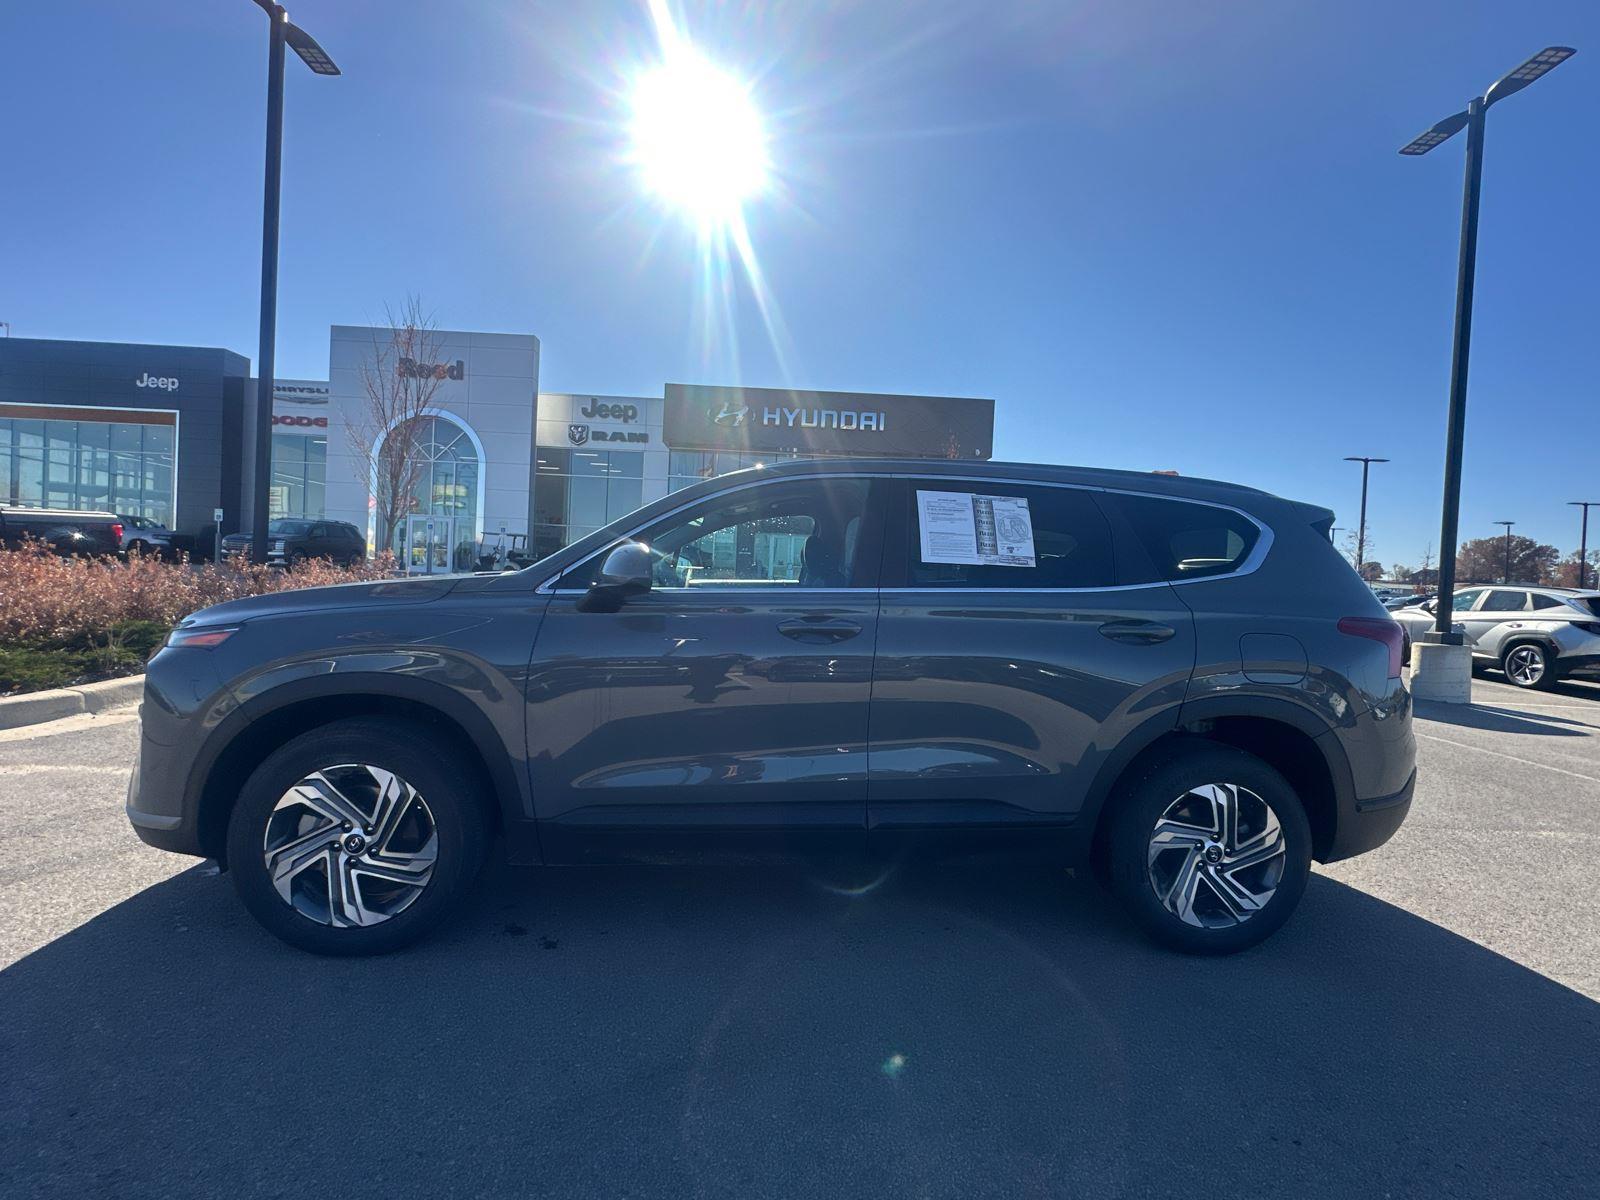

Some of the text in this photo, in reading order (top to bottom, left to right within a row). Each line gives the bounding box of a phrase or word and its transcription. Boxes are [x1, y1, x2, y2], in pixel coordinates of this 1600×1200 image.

[136, 372, 179, 392] Jeep
[581, 397, 638, 423] Jeep
[762, 407, 886, 432] HYUNDAI
[591, 430, 649, 444] RAM
